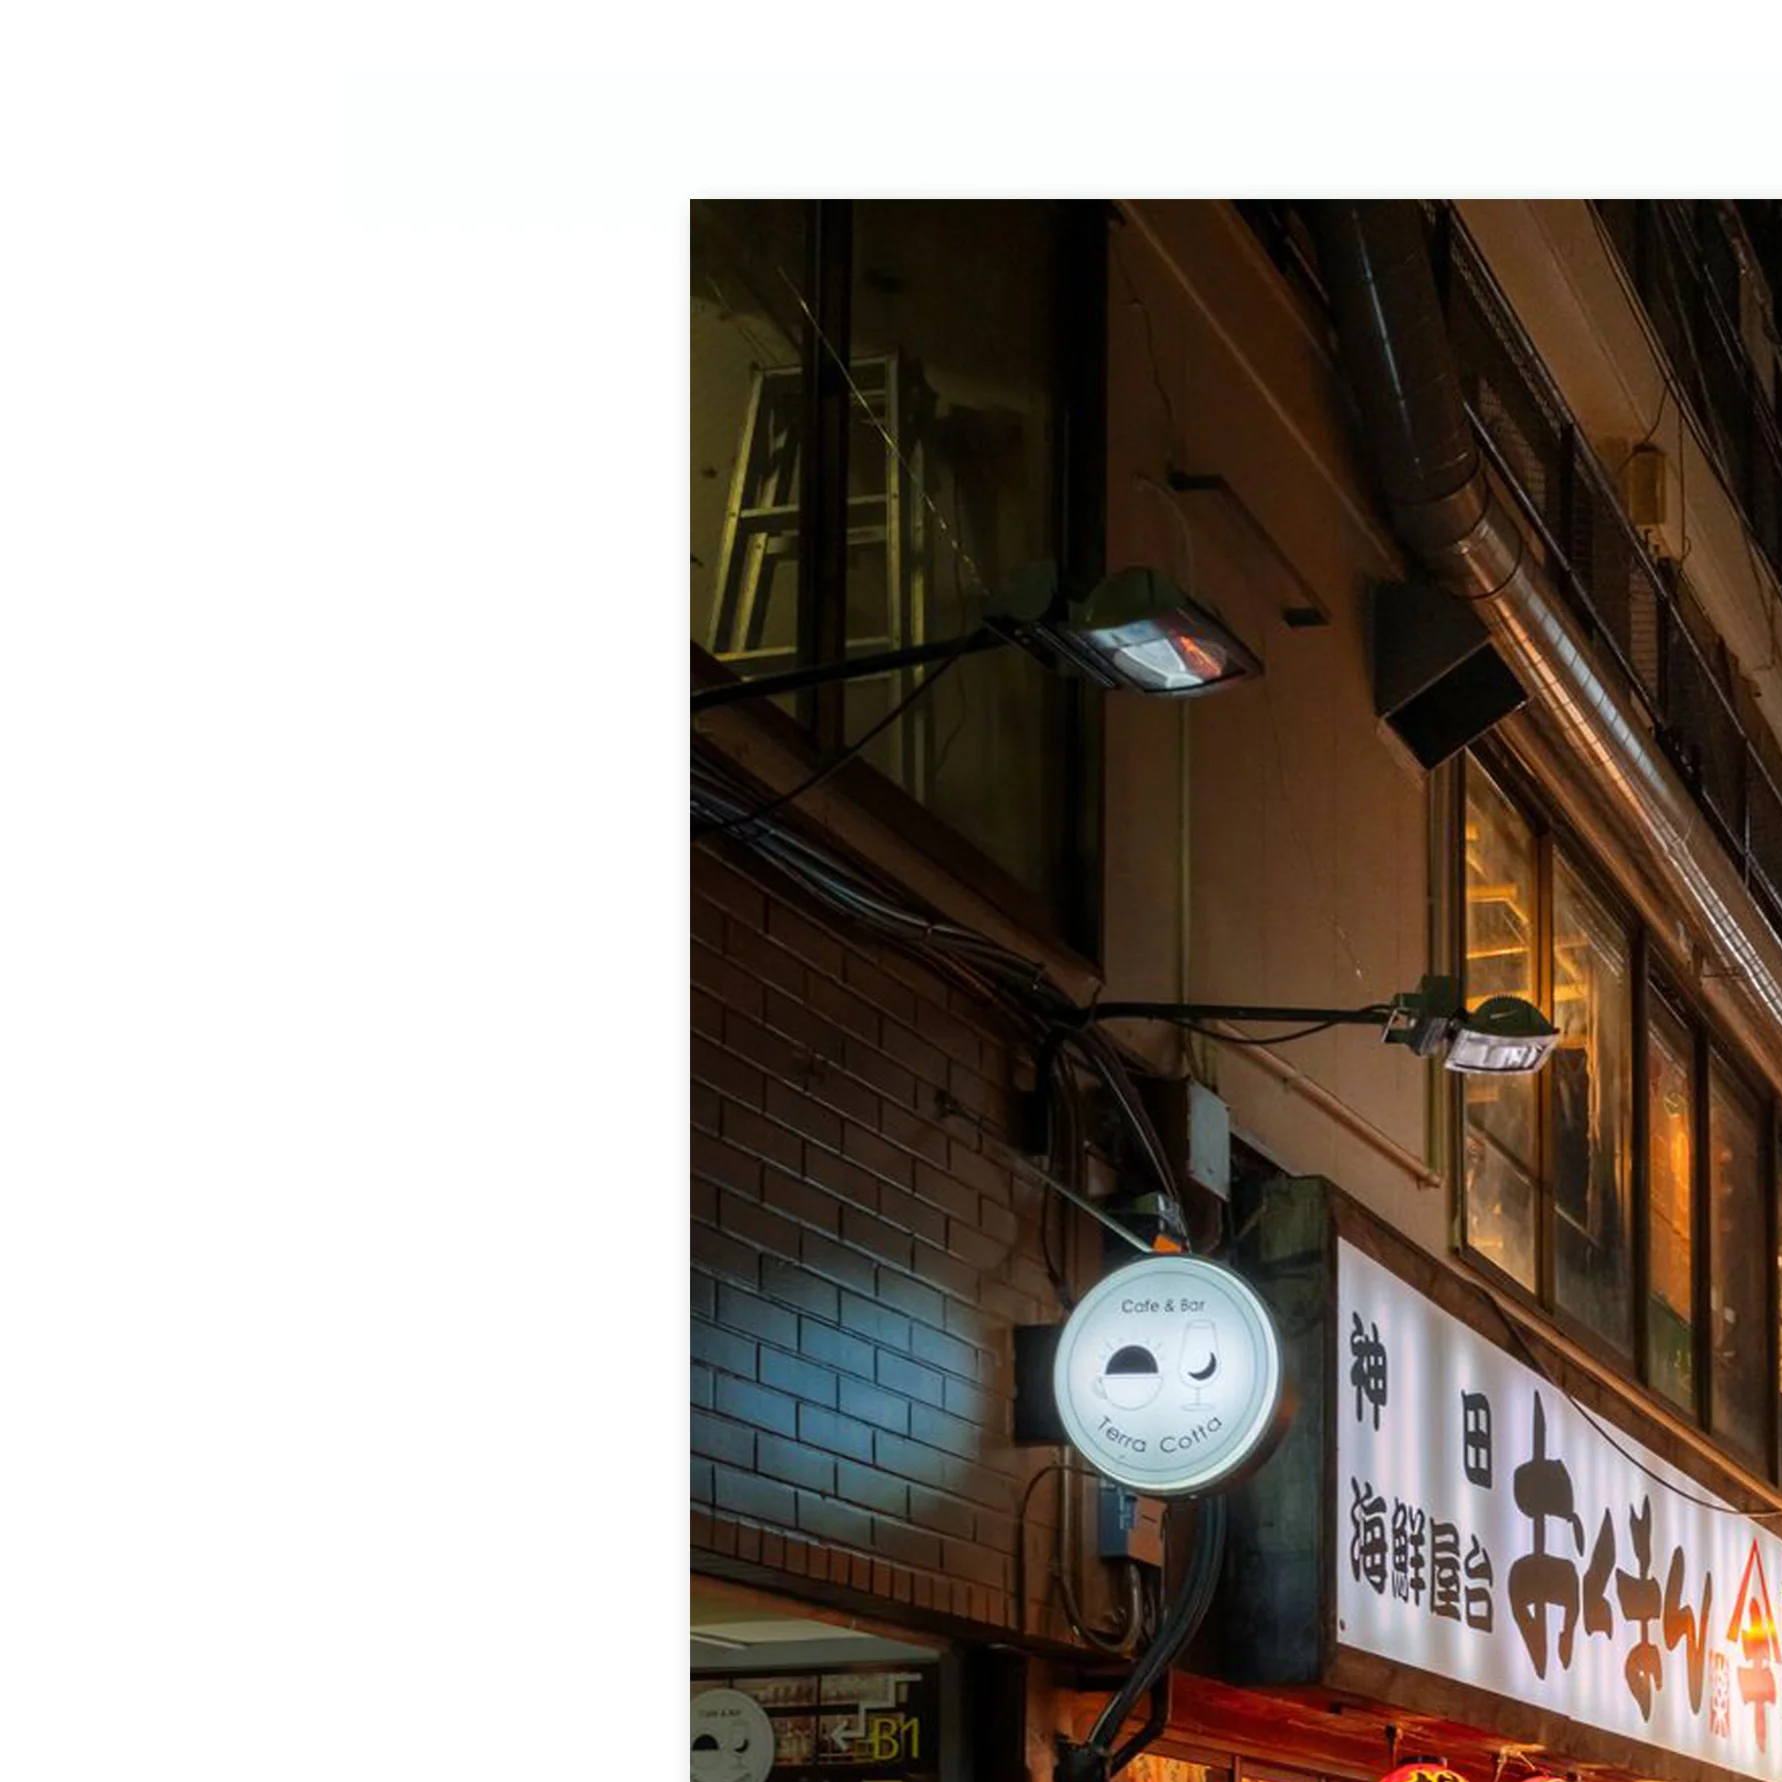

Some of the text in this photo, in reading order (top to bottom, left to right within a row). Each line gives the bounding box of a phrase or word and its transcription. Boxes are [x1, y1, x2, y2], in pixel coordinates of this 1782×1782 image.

[1121, 1299, 1206, 1313] Cafe & Bar
[1098, 1416, 1222, 1453] Terra Cotta
[1350, 1479, 1494, 1634] 海鮮屋台
[1508, 1390, 1713, 1721] おくまん
[872, 1717, 919, 1760] B1
